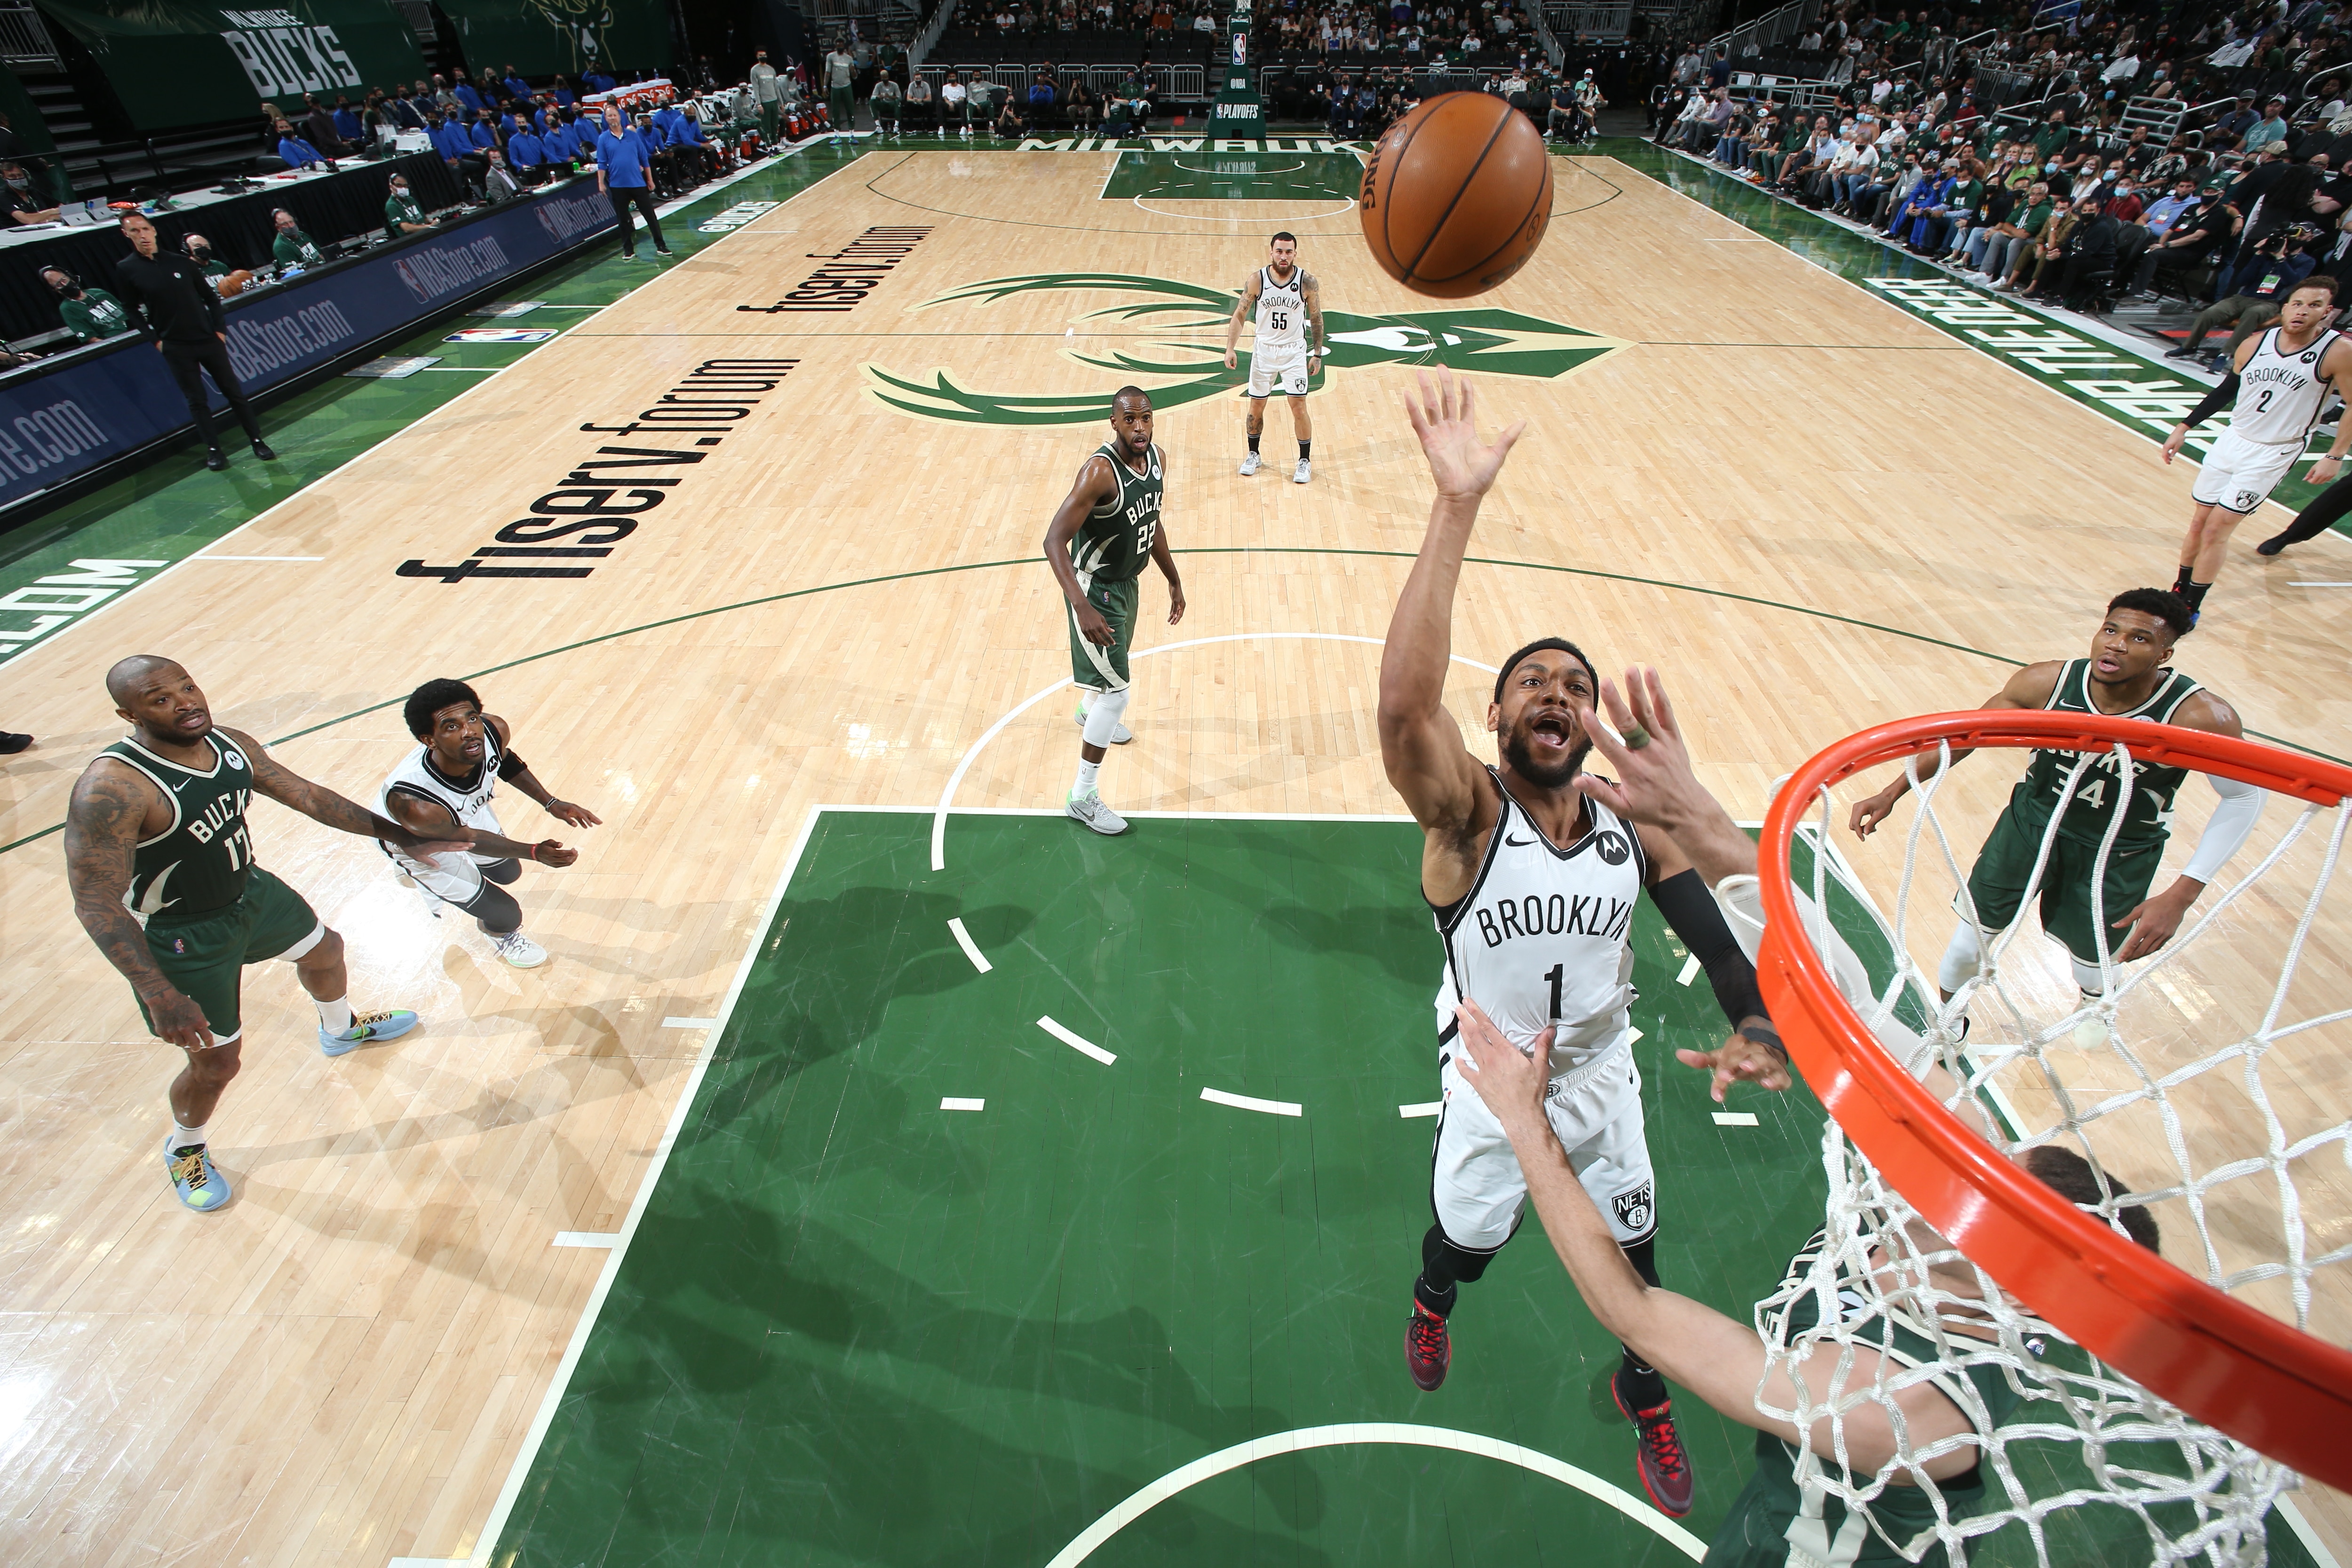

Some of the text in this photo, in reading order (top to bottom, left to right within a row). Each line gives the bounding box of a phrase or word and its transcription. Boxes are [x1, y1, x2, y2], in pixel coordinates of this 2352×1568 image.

[220, 9, 304, 28] MILWAUKEE
[220, 25, 362, 98] BUCKS
[1230, 78, 1246, 89] @NBA
[1223, 104, 1258, 119] PLAYOFFS
[1016, 138, 1375, 153] MILWAUK
[543, 192, 617, 240] NBAStore.com
[698, 201, 781, 232] @BUCKS
[406, 235, 509, 298] NBAStore.com
[736, 226, 935, 314] fiserv.forum
[1261, 296, 1301, 310] BROOKLYN
[1862, 278, 2045, 325] DEER
[1271, 312, 1287, 330] 55
[1963, 329, 2144, 374] THE
[2246, 367, 2309, 391] BROOKLYN
[2256, 390, 2273, 414] 2
[396, 359, 802, 583] fiserv.forum
[2238, 491, 2258, 501] NETS
[1136, 519, 1157, 555] 22
[187, 788, 253, 844] BUCK
[224, 825, 252, 872] 17
[1476, 894, 1632, 948] BROOKLYN
[1544, 963, 1564, 1019] 1
[1618, 1183, 1650, 1214] NETS
